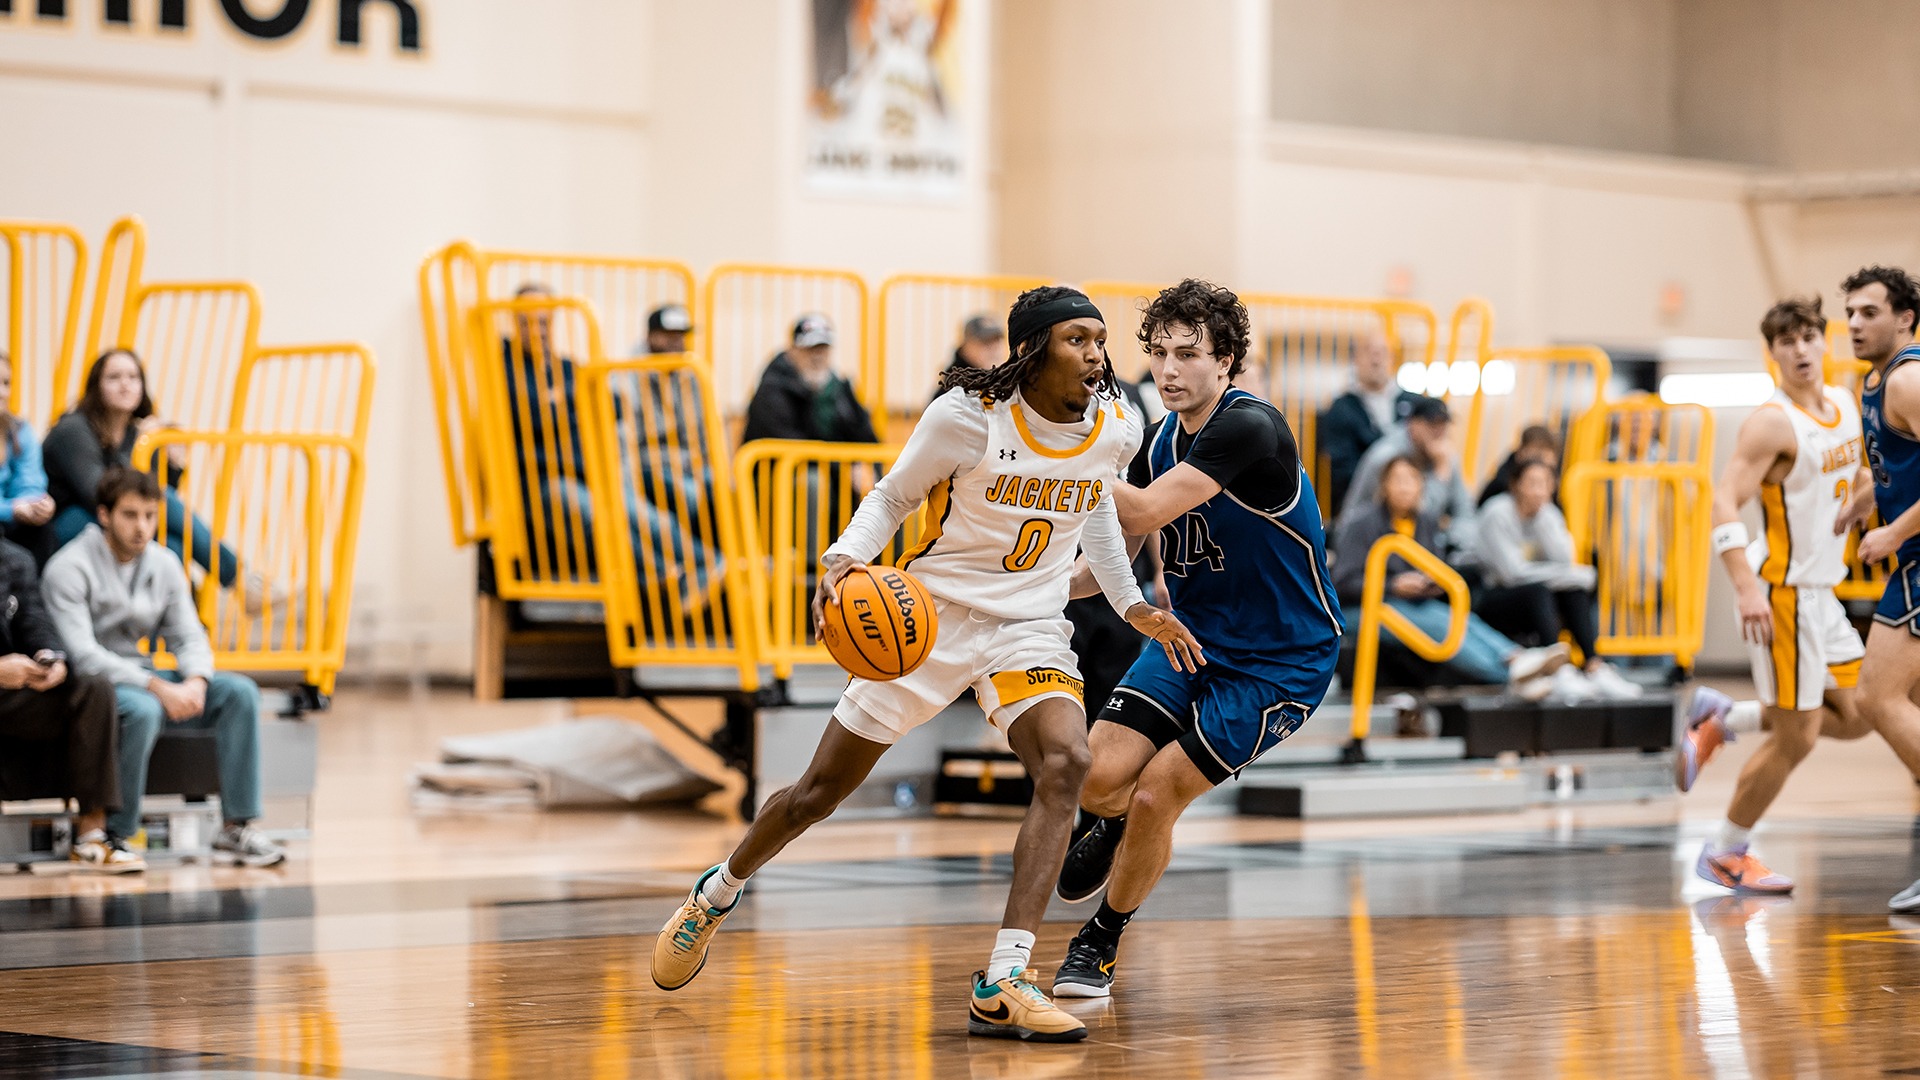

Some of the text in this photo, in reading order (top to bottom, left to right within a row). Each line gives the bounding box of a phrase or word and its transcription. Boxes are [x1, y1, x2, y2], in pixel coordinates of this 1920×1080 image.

[985, 475, 1103, 513] JACKETS
[1002, 518, 1054, 573] 0
[854, 599, 882, 639] EVO
[883, 573, 917, 647] Wilson
